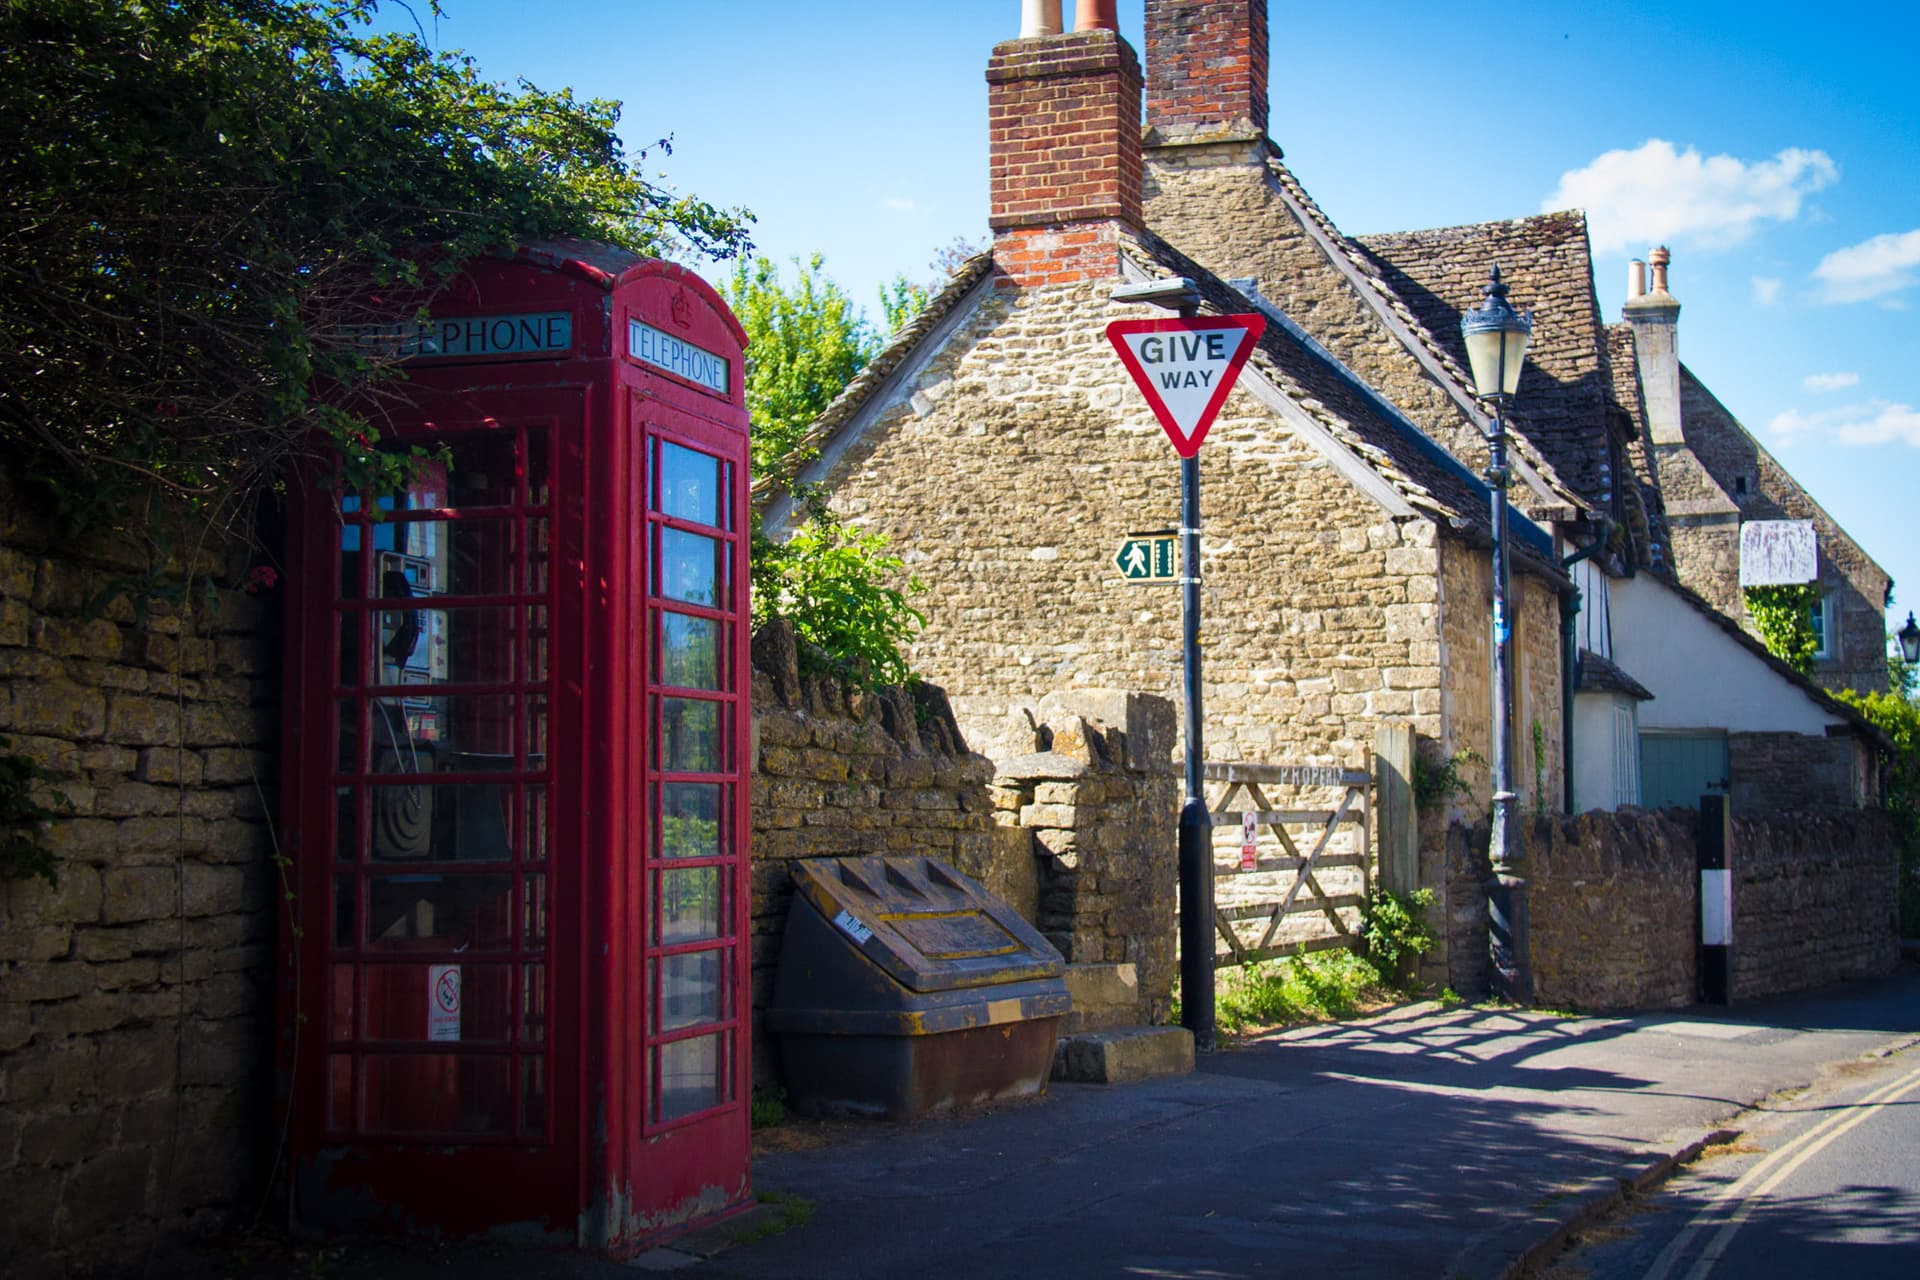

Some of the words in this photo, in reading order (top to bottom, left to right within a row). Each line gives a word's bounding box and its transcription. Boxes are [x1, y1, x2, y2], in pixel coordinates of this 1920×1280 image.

[629, 322, 721, 389] TELEPHONE
[1141, 333, 1225, 364] GIVE
[1160, 369, 1214, 390] WAY
